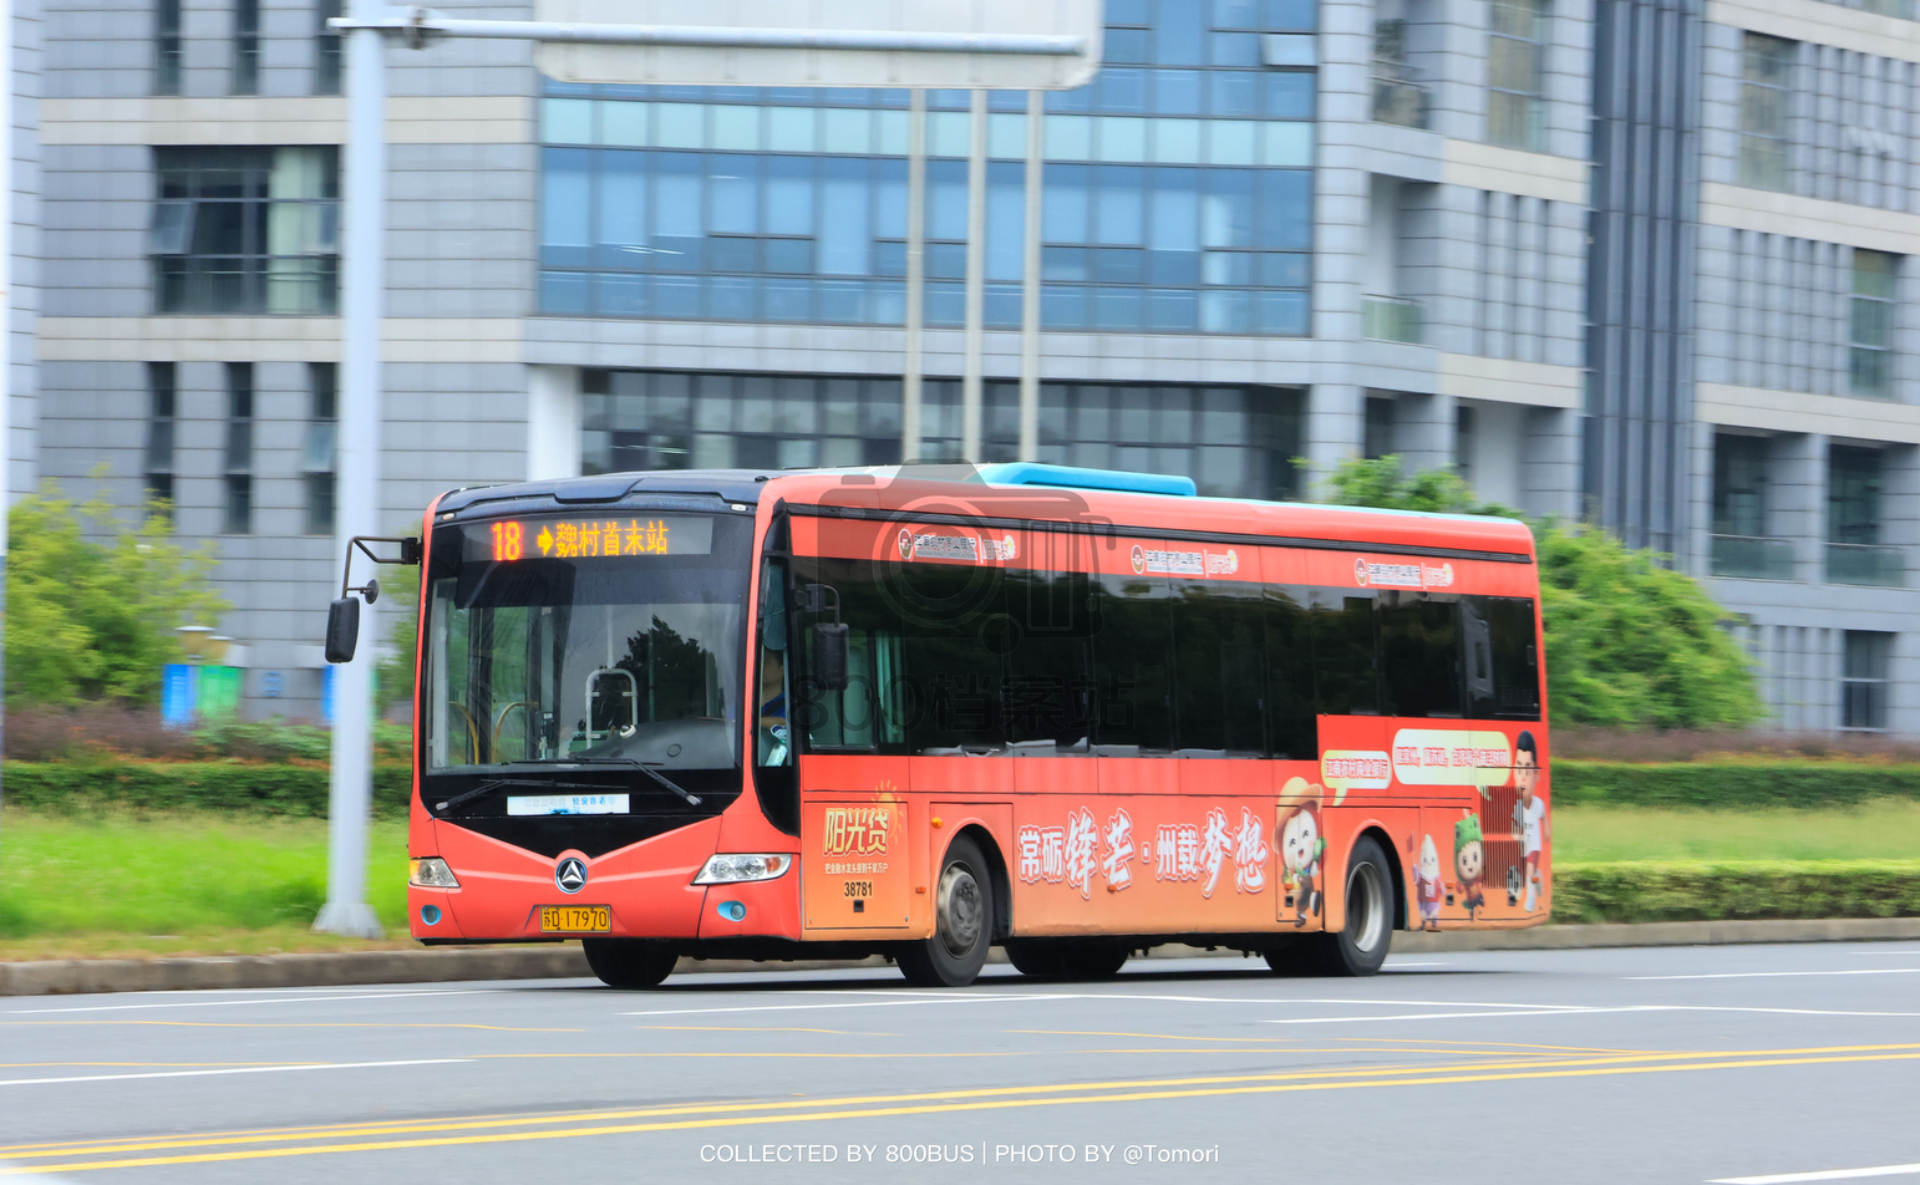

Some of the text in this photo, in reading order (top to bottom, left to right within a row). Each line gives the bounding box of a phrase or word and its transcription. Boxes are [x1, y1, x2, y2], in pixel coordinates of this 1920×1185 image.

[491, 521, 523, 560] 18
[555, 519, 669, 557] 魏村首末站
[824, 808, 889, 857] 阳光贷
[844, 881, 873, 897] 38781
